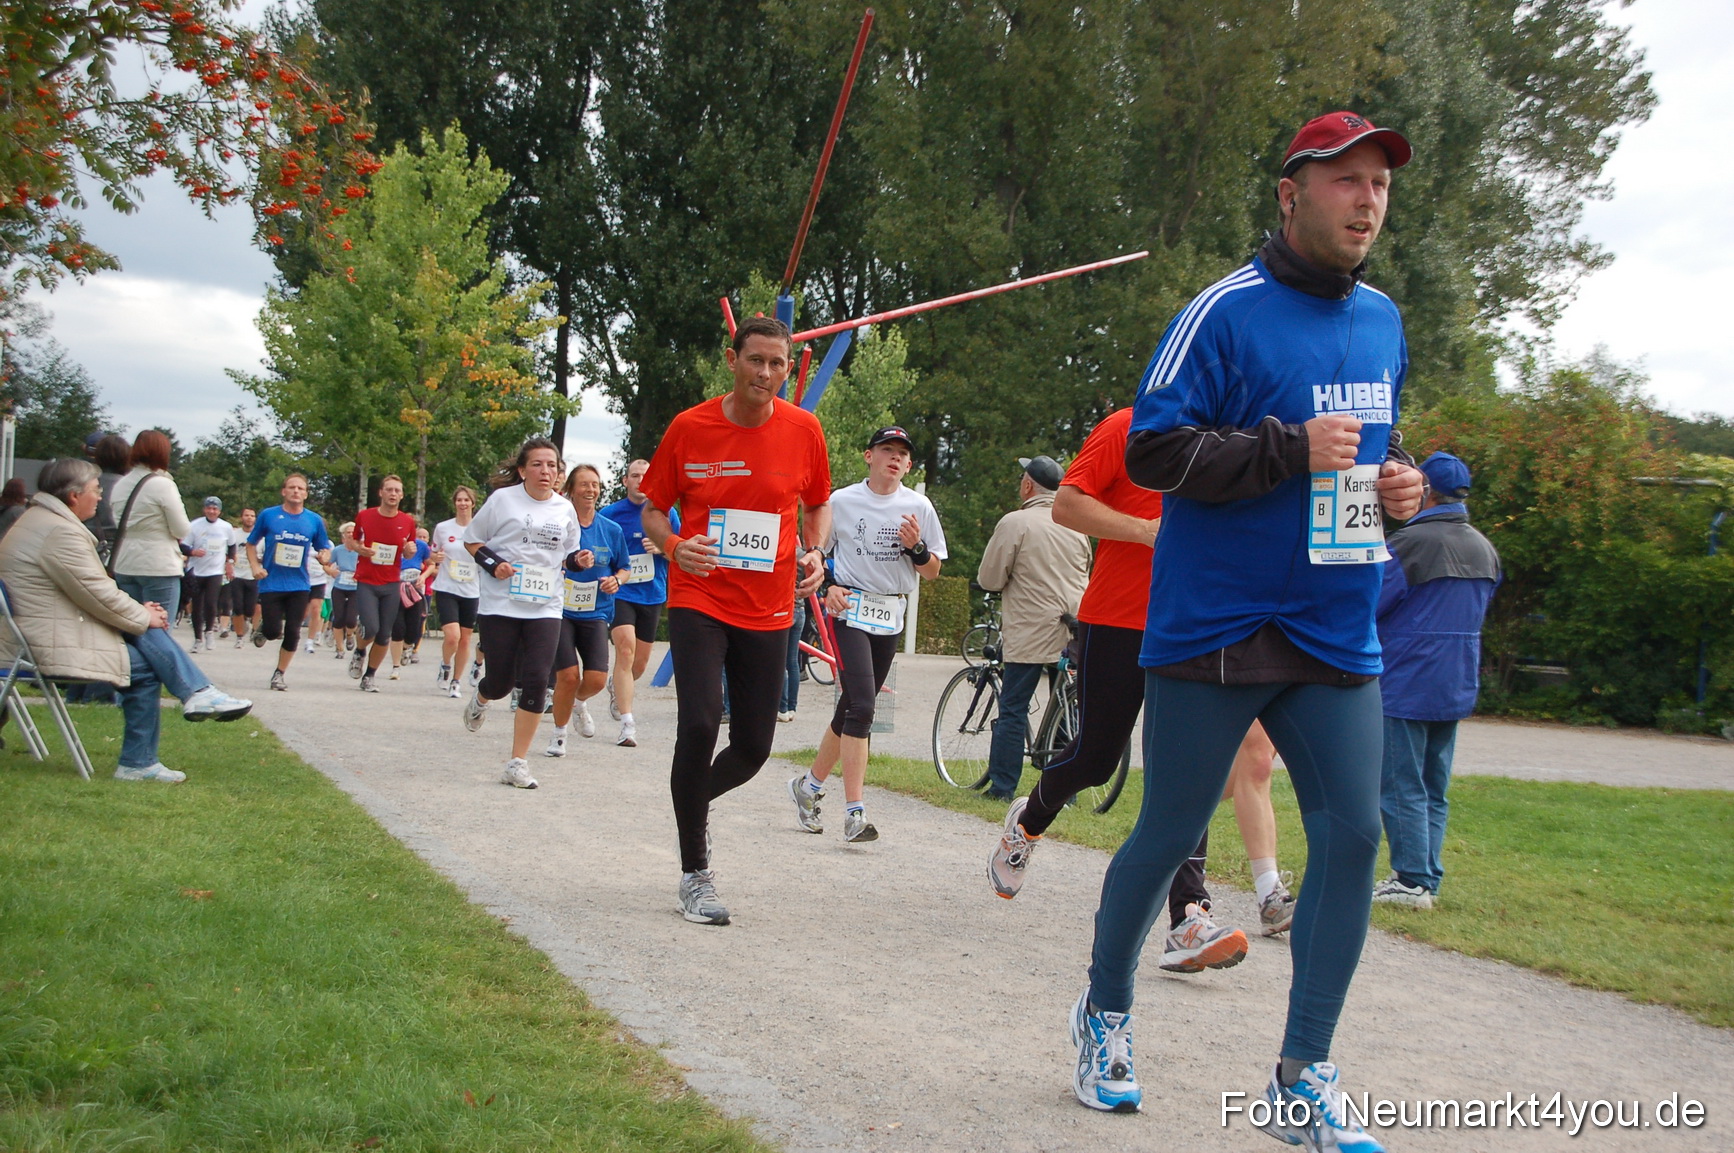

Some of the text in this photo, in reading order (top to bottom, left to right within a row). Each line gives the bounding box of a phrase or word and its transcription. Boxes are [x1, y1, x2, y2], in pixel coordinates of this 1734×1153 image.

[1318, 503, 1325, 516] B
[728, 531, 769, 550] 3450
[632, 565, 648, 574] 731
[524, 578, 550, 592] 3121
[574, 593, 592, 603] 538
[862, 605, 891, 622] 3120
